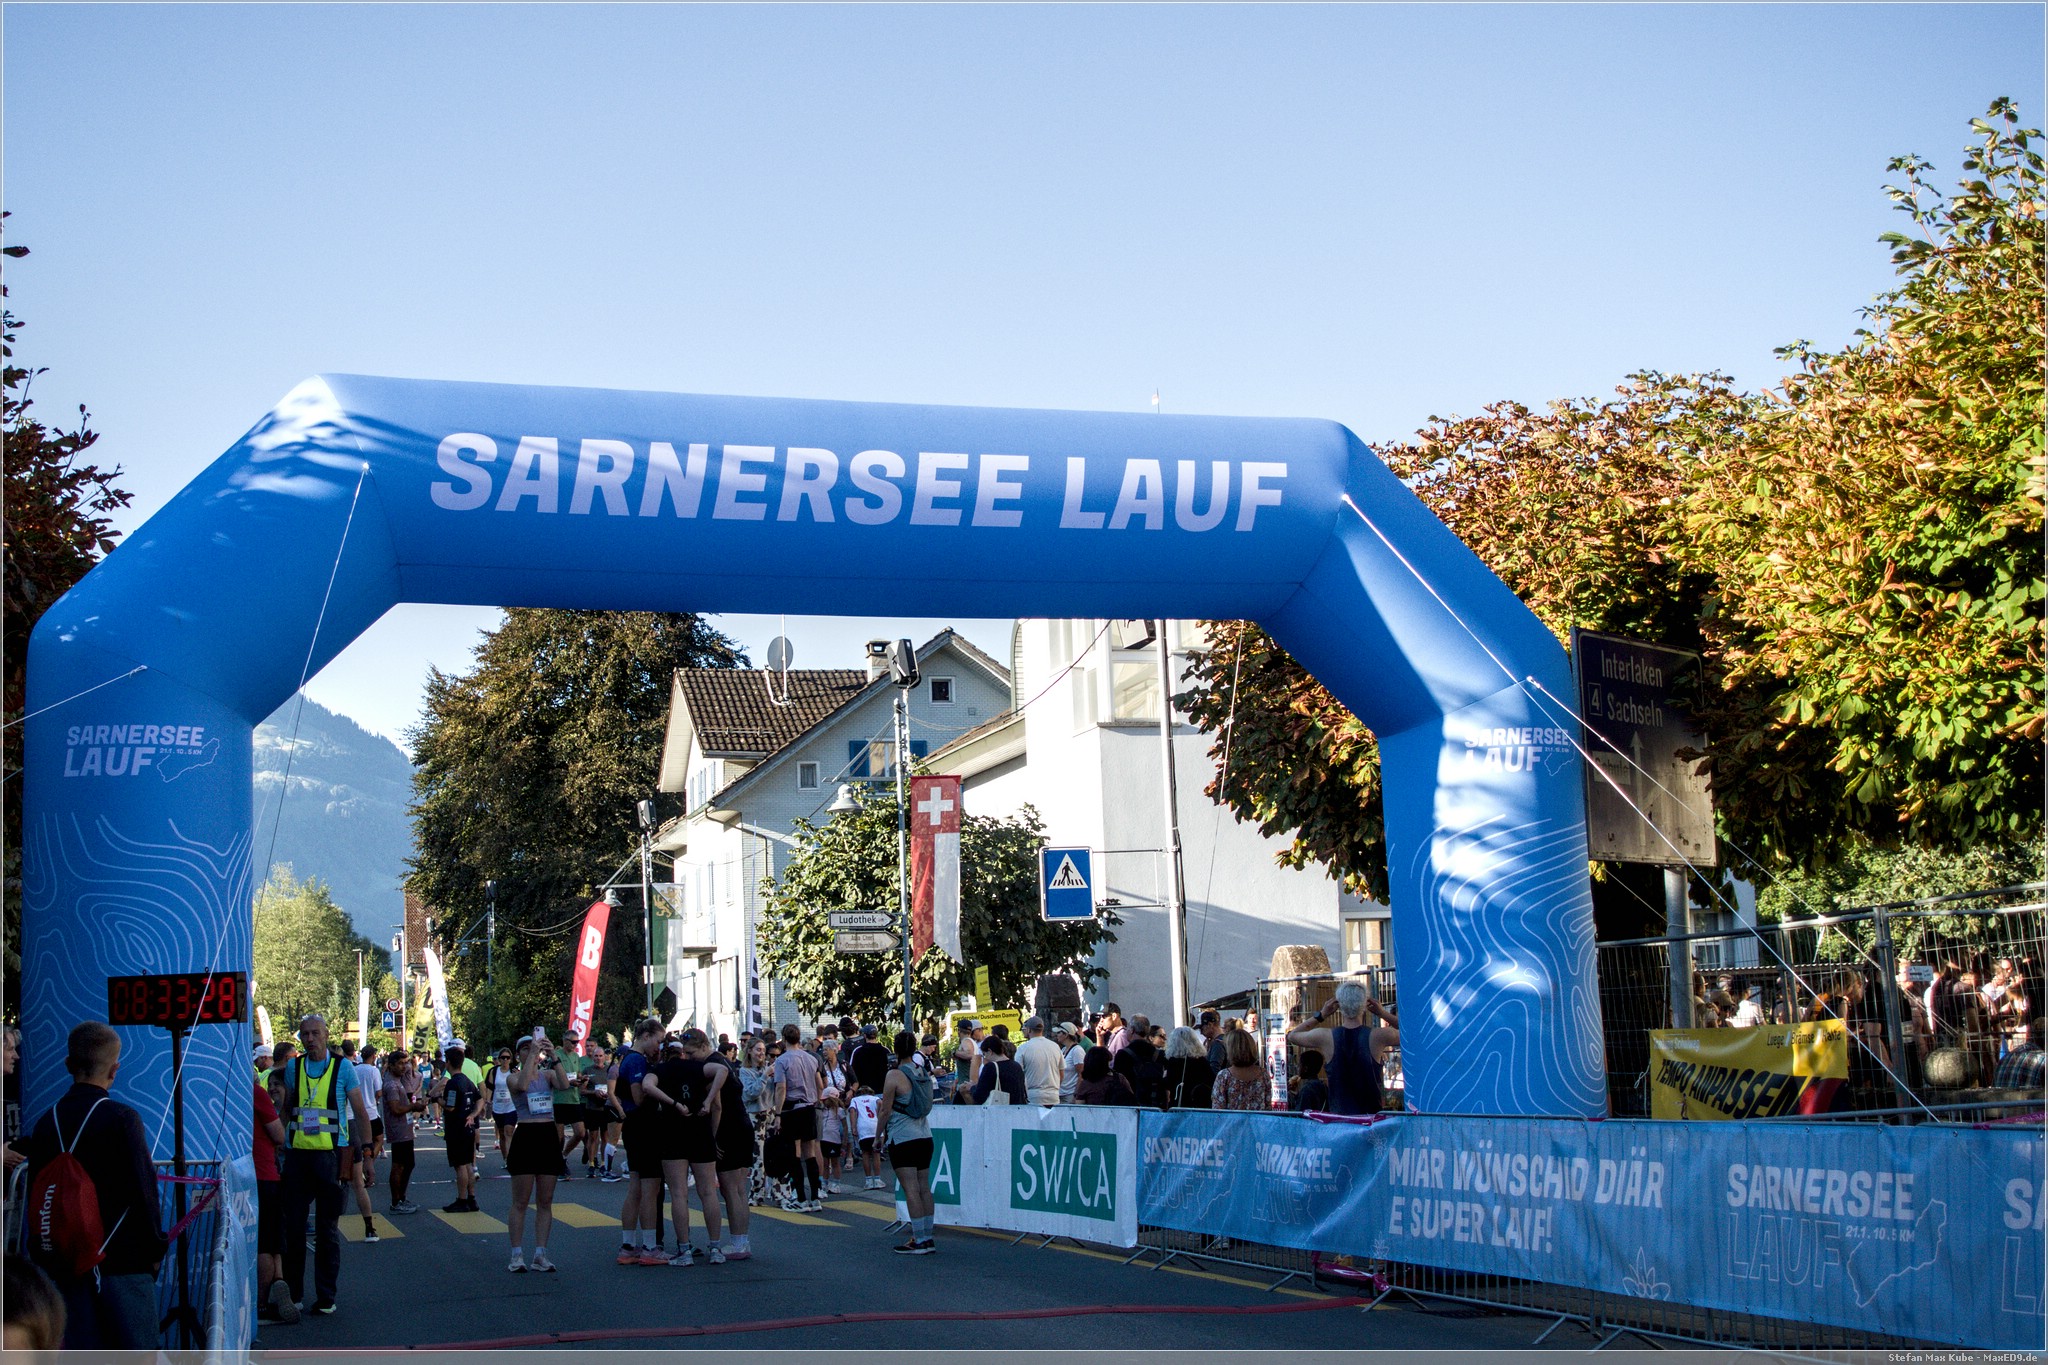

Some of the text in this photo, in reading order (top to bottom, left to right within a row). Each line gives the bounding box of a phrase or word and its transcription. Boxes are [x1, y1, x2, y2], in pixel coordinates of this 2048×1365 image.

[430, 431, 1288, 533] SARNERSEE LAUF
[1600, 649, 1663, 688] Interlaken
[1591, 687, 1663, 728] 4 Sachseln
[66, 724, 205, 747] SARNERSEE
[1464, 727, 1569, 748] SARNERSEE
[63, 746, 157, 778] LAUF
[839, 915, 877, 924] Ludothek
[580, 924, 602, 970] B
[114, 977, 236, 1020] 08:33:28
[1656, 1058, 1808, 1120] TEMPO ANPASSEN
[1143, 1136, 1225, 1168] SARNERSEE
[1255, 1141, 1333, 1180] SARNERSEE
[1389, 1136, 1665, 1208] MIÄR WÜNSCHID DIÄR
[1726, 1163, 1915, 1221] SARNERSEE
[1389, 1195, 1552, 1254] E SUPER LAIF!
[1726, 1212, 1841, 1288] LAUF
[1899, 1229, 1916, 1242] KM
